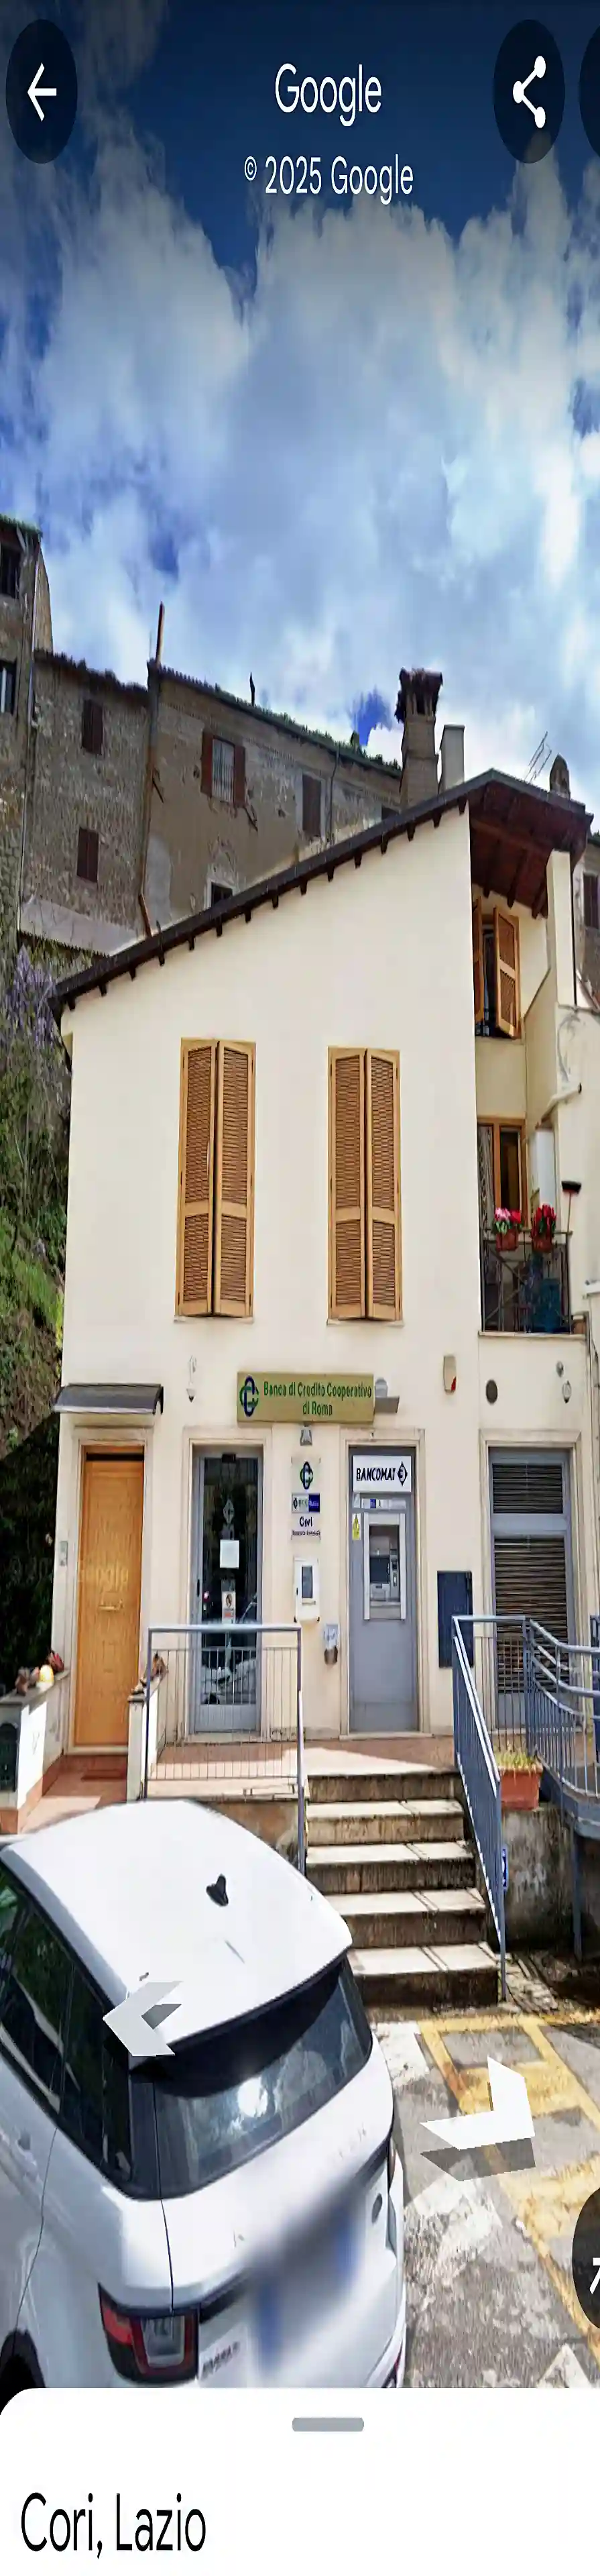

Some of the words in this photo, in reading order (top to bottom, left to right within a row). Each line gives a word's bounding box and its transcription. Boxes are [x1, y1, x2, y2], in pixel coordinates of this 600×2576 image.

[263, 1381, 287, 1397] Banca
[288, 1381, 296, 1397] di
[297, 1381, 326, 1398] Credito
[326, 1382, 372, 1401] Cooperativo
[302, 1400, 310, 1415] di
[312, 1401, 333, 1416] Roma
[356, 1467, 396, 1481] BANCOMAT
